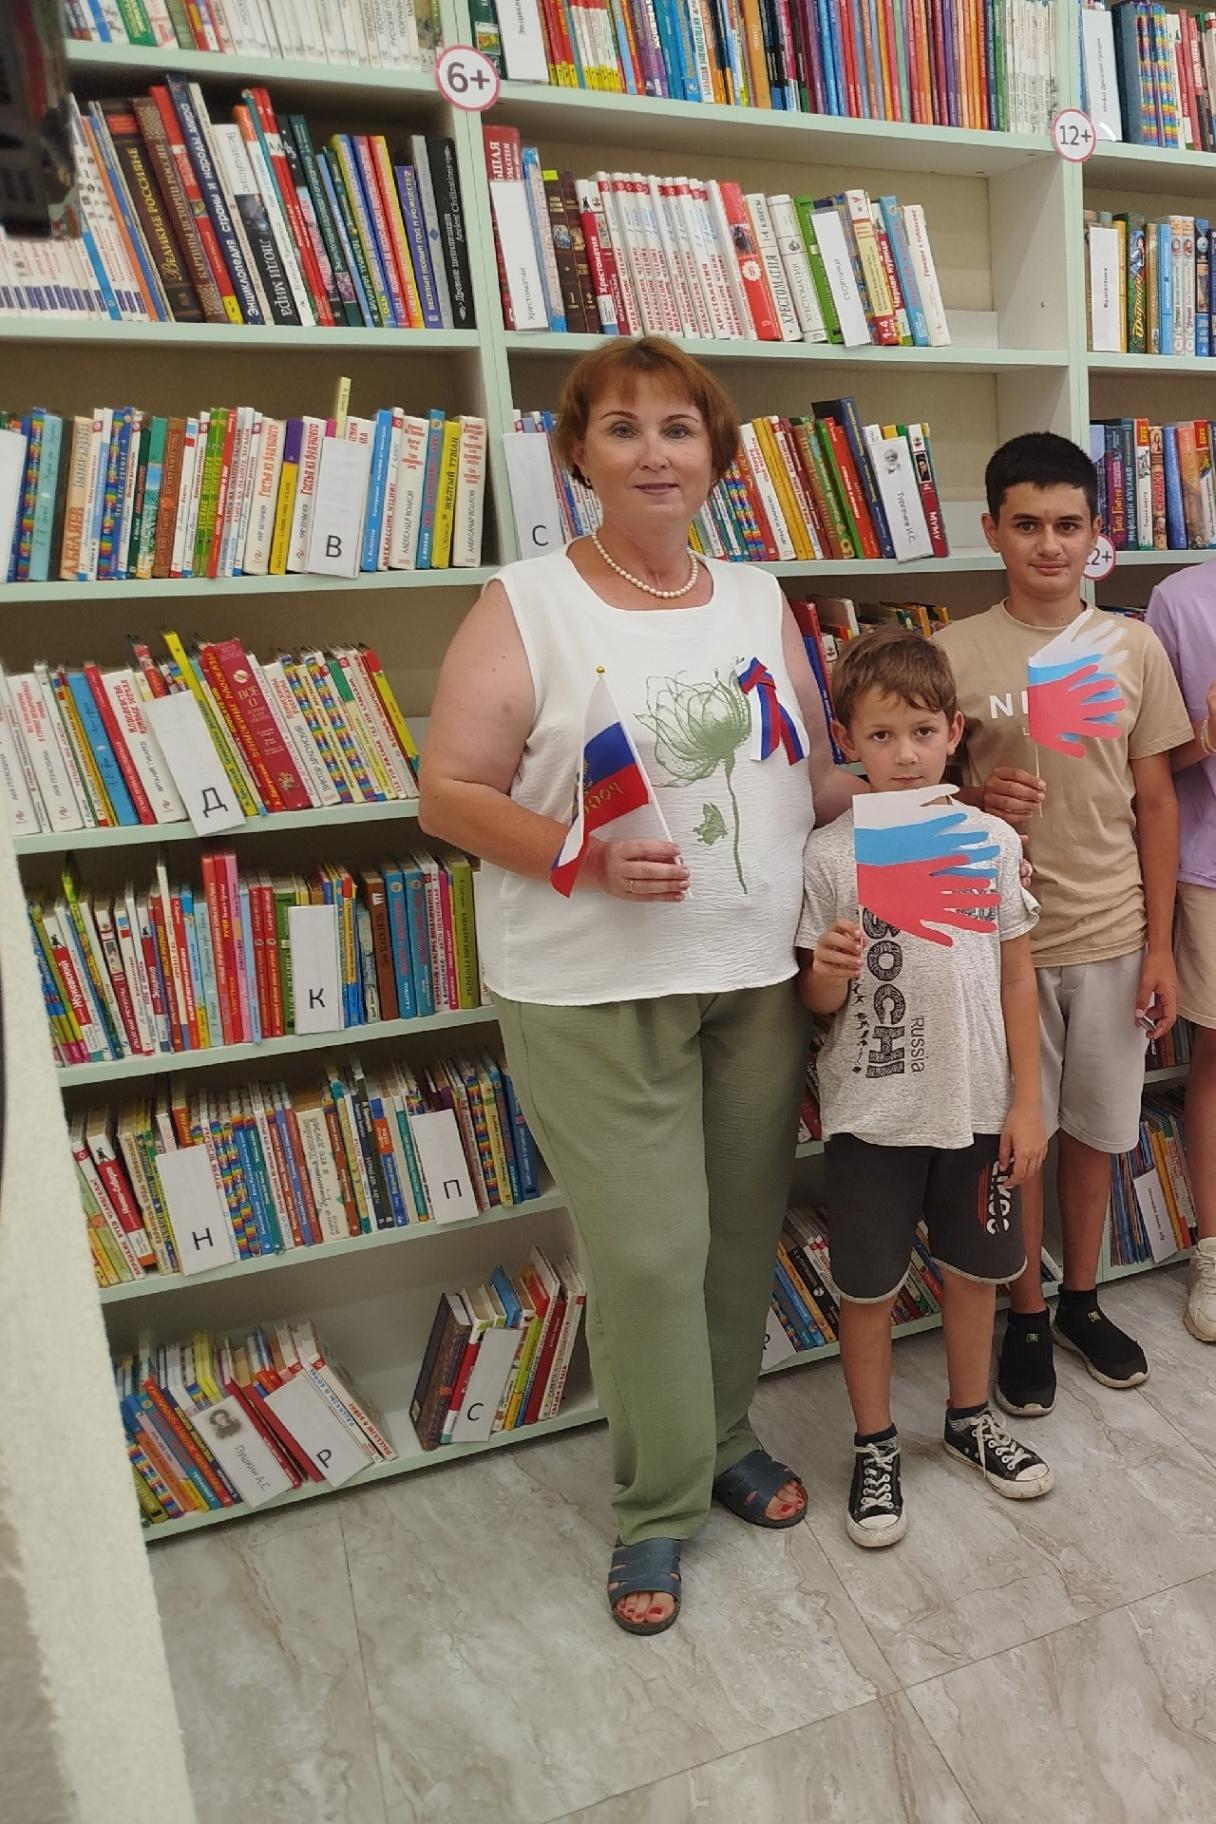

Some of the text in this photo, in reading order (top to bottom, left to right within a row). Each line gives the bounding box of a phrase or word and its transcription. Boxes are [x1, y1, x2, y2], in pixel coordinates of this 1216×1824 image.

[447, 62, 490, 95] 6+
[1059, 124, 1092, 146] 12+
[129, 146, 156, 213] РОССИЯНЕ
[490, 141, 503, 181] ЬШАЯ
[447, 164, 463, 242] Ancient Civilizations
[591, 235, 606, 294] Хрестоматия
[880, 240, 895, 273] курица
[766, 253, 793, 325] ХРЕСТОМАТИЯ
[792, 263, 812, 322] ХРЕСТОМАТИЯ
[881, 319, 892, 339] 1-4
[263, 424, 278, 461] будущего
[305, 423, 319, 460] будущего
[260, 473, 273, 497] Гостья
[302, 470, 314, 495] Гостья
[444, 437, 459, 510] ЖЕЛТЫЙ ТУМАН
[896, 491, 910, 528] Тургенев
[325, 534, 344, 559] В
[402, 517, 411, 554] АЛЕКСАНДР
[532, 524, 549, 546] С
[205, 651, 234, 700] РАССКАЗЫ
[113, 684, 137, 734] КОРОЛЕВСТВО
[121, 678, 147, 735] КРИВЫХ ЗЕРКАЛ
[270, 677, 294, 721] Денискины
[228, 702, 260, 759] ДЕНИСКИНЫ
[295, 724, 330, 793] ВИКТОР ДРАГУНСКИЙ
[203, 787, 229, 819] Д
[59, 958, 83, 1009] Жуковский
[148, 966, 161, 999] Зощенко
[309, 987, 325, 1009] К
[444, 1179, 462, 1200] П
[466, 1402, 484, 1422] С
[316, 1448, 332, 1469] Р
